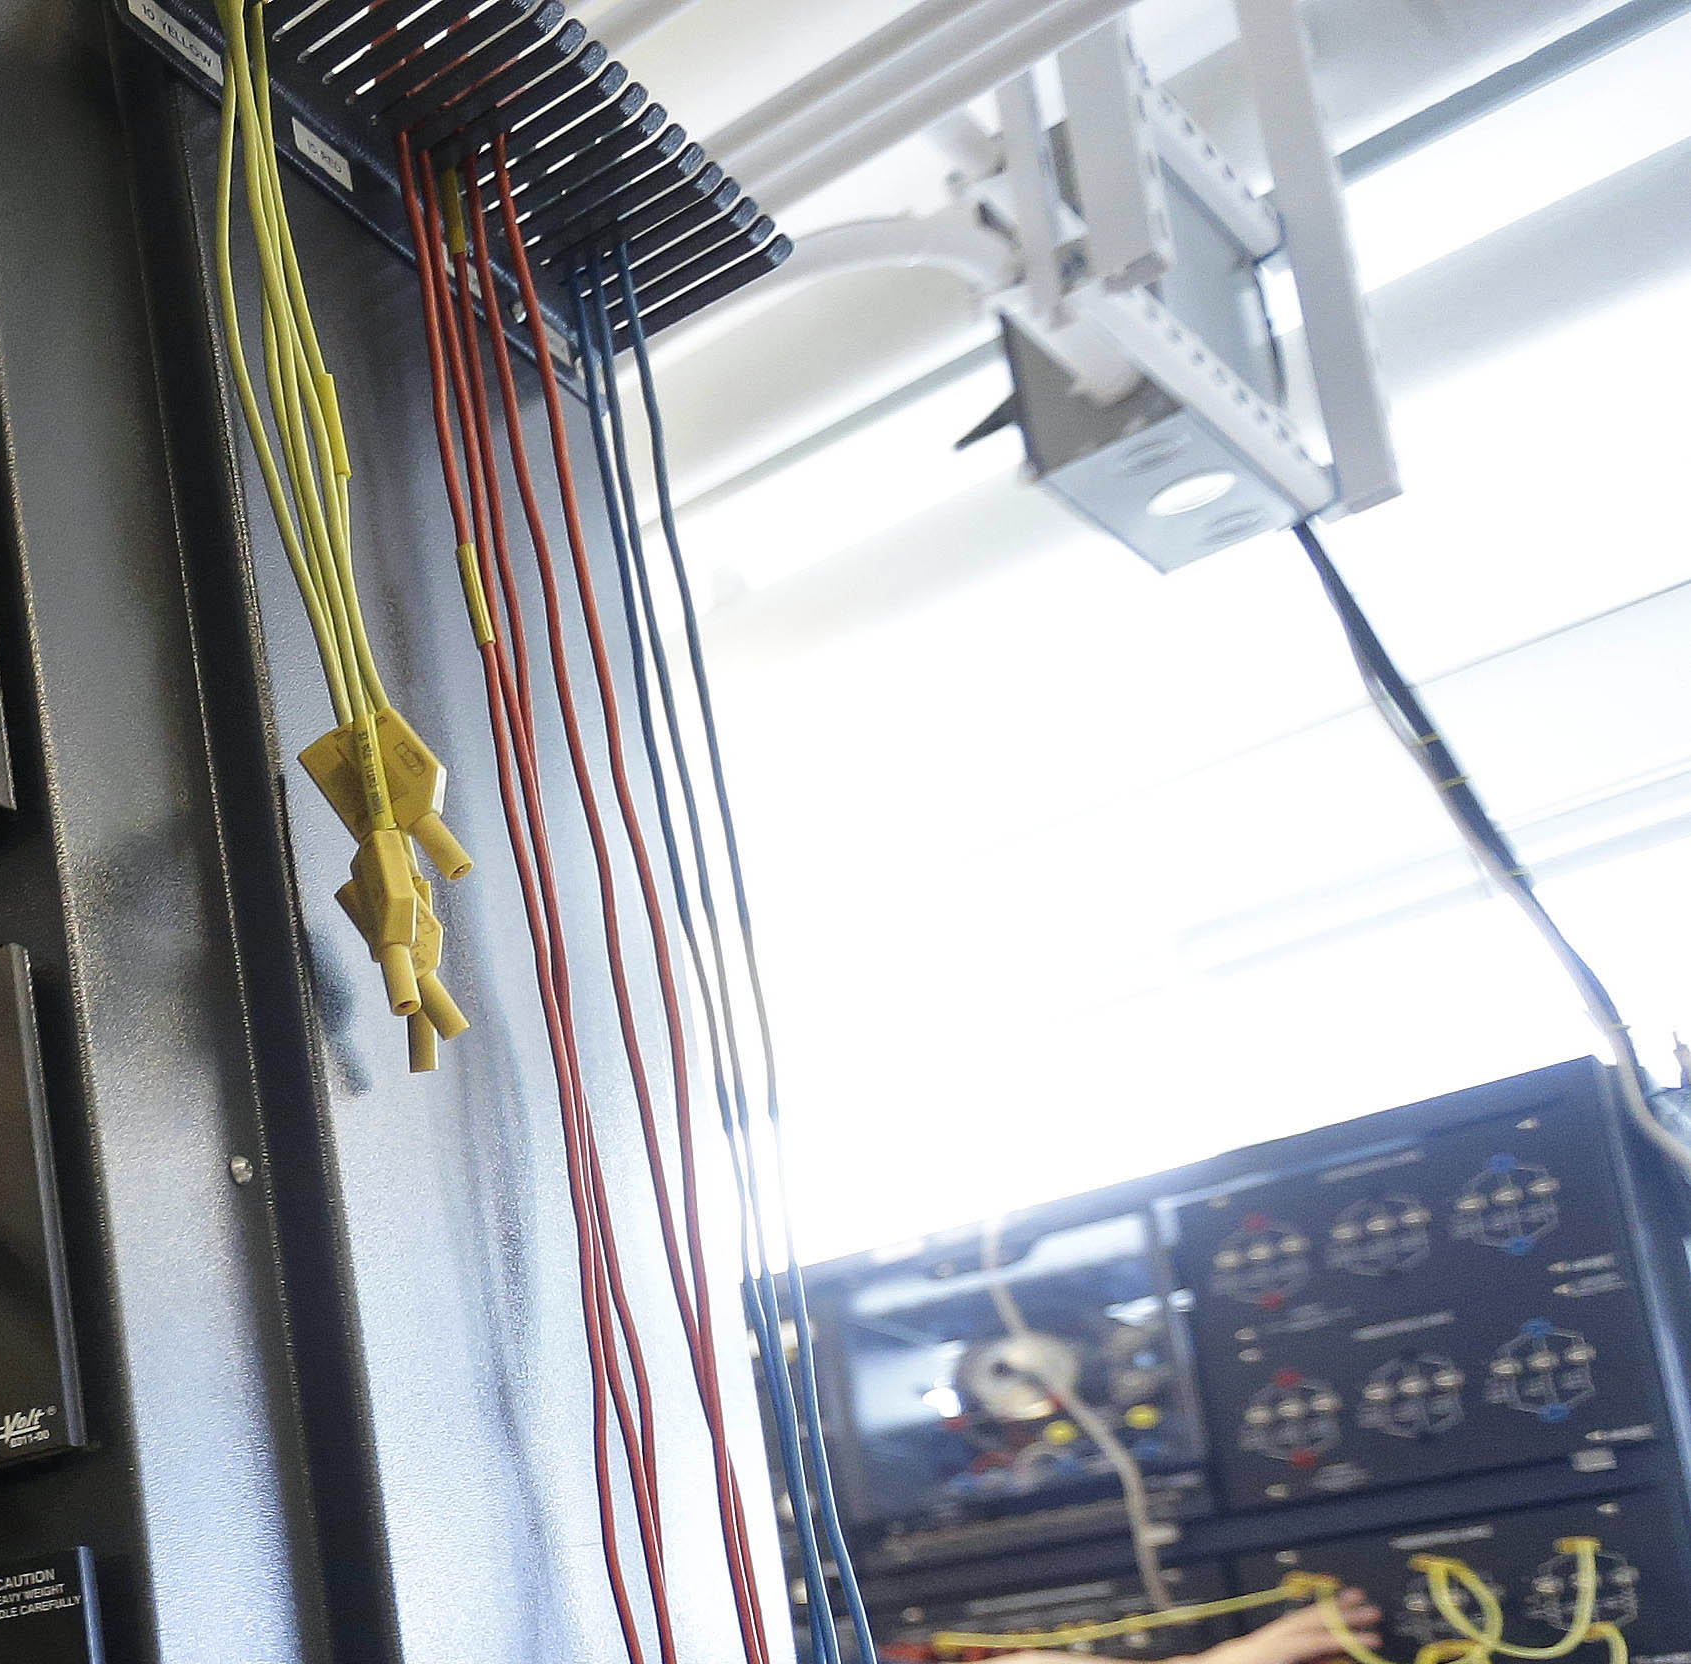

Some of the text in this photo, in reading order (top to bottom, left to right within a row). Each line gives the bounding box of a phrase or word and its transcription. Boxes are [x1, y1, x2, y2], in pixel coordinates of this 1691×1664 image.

[162, 22, 212, 67] YELLOW
[23, 1583, 65, 1600] WEIGHT
[19, 1595, 81, 1616] CAREFULLY
